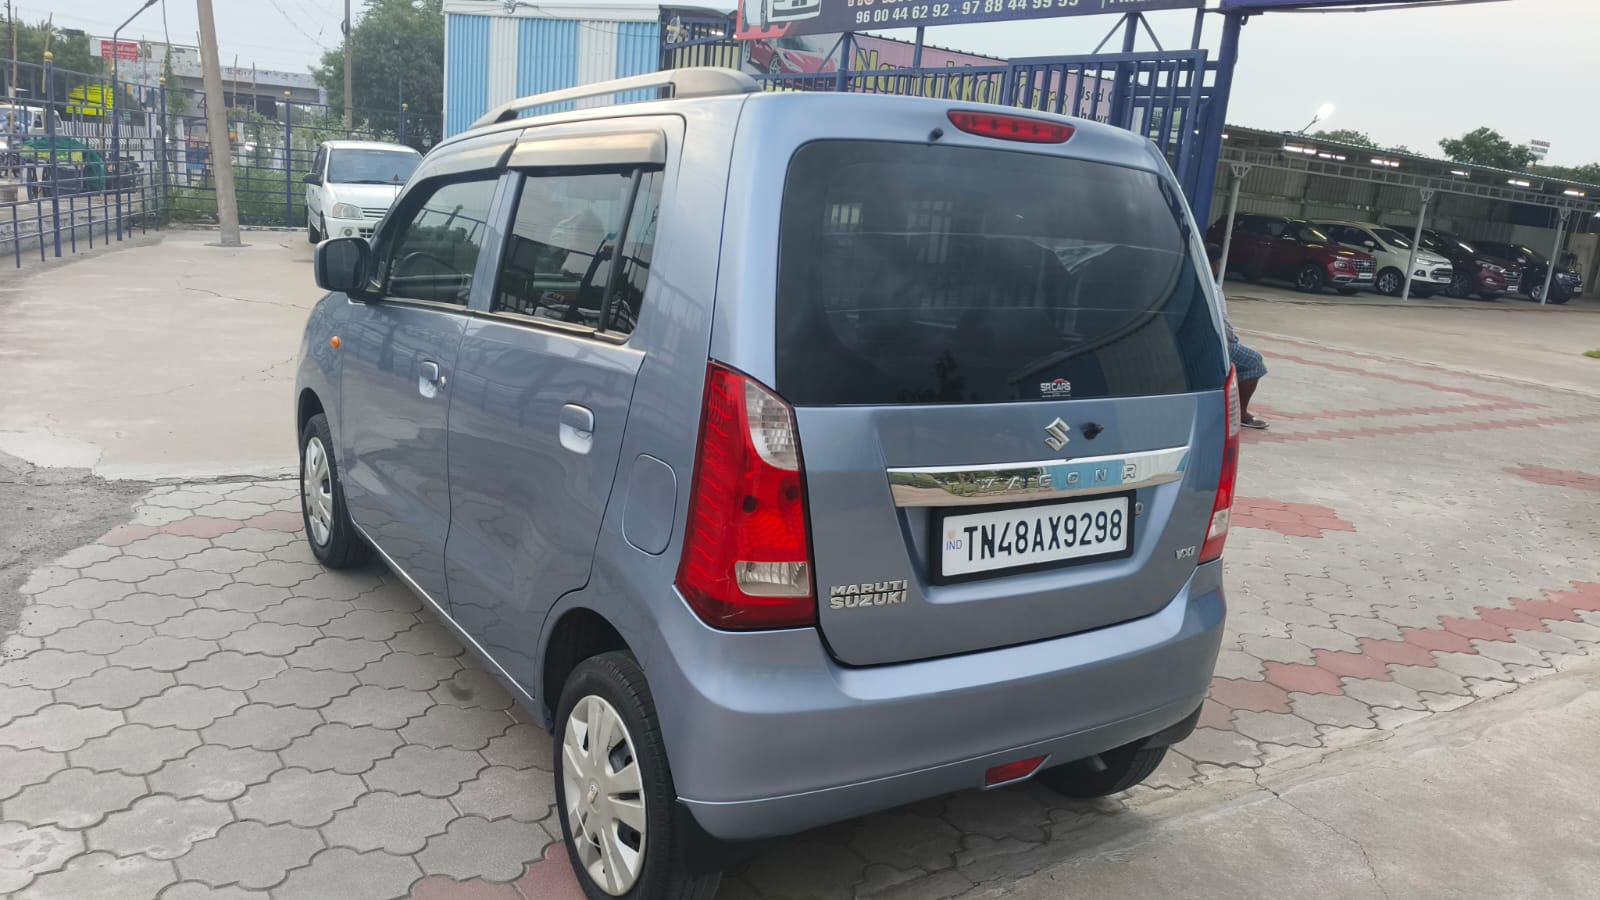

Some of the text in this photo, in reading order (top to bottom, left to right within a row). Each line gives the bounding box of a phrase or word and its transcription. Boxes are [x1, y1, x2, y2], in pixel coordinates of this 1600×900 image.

[856, 10, 870, 23] 96
[874, 9, 889, 22] 00
[892, 7, 908, 20] 44
[912, 5, 928, 19] 62
[933, 4, 949, 17] 92
[962, 1, 979, 15] 97
[985, 0, 1001, 13] 88
[1008, 0, 1027, 11] 44
[946, 539, 963, 551] IND
[963, 509, 1123, 562] TN48AX9298
[830, 579, 908, 597] MARUTI
[830, 590, 908, 610] SUZUKI
